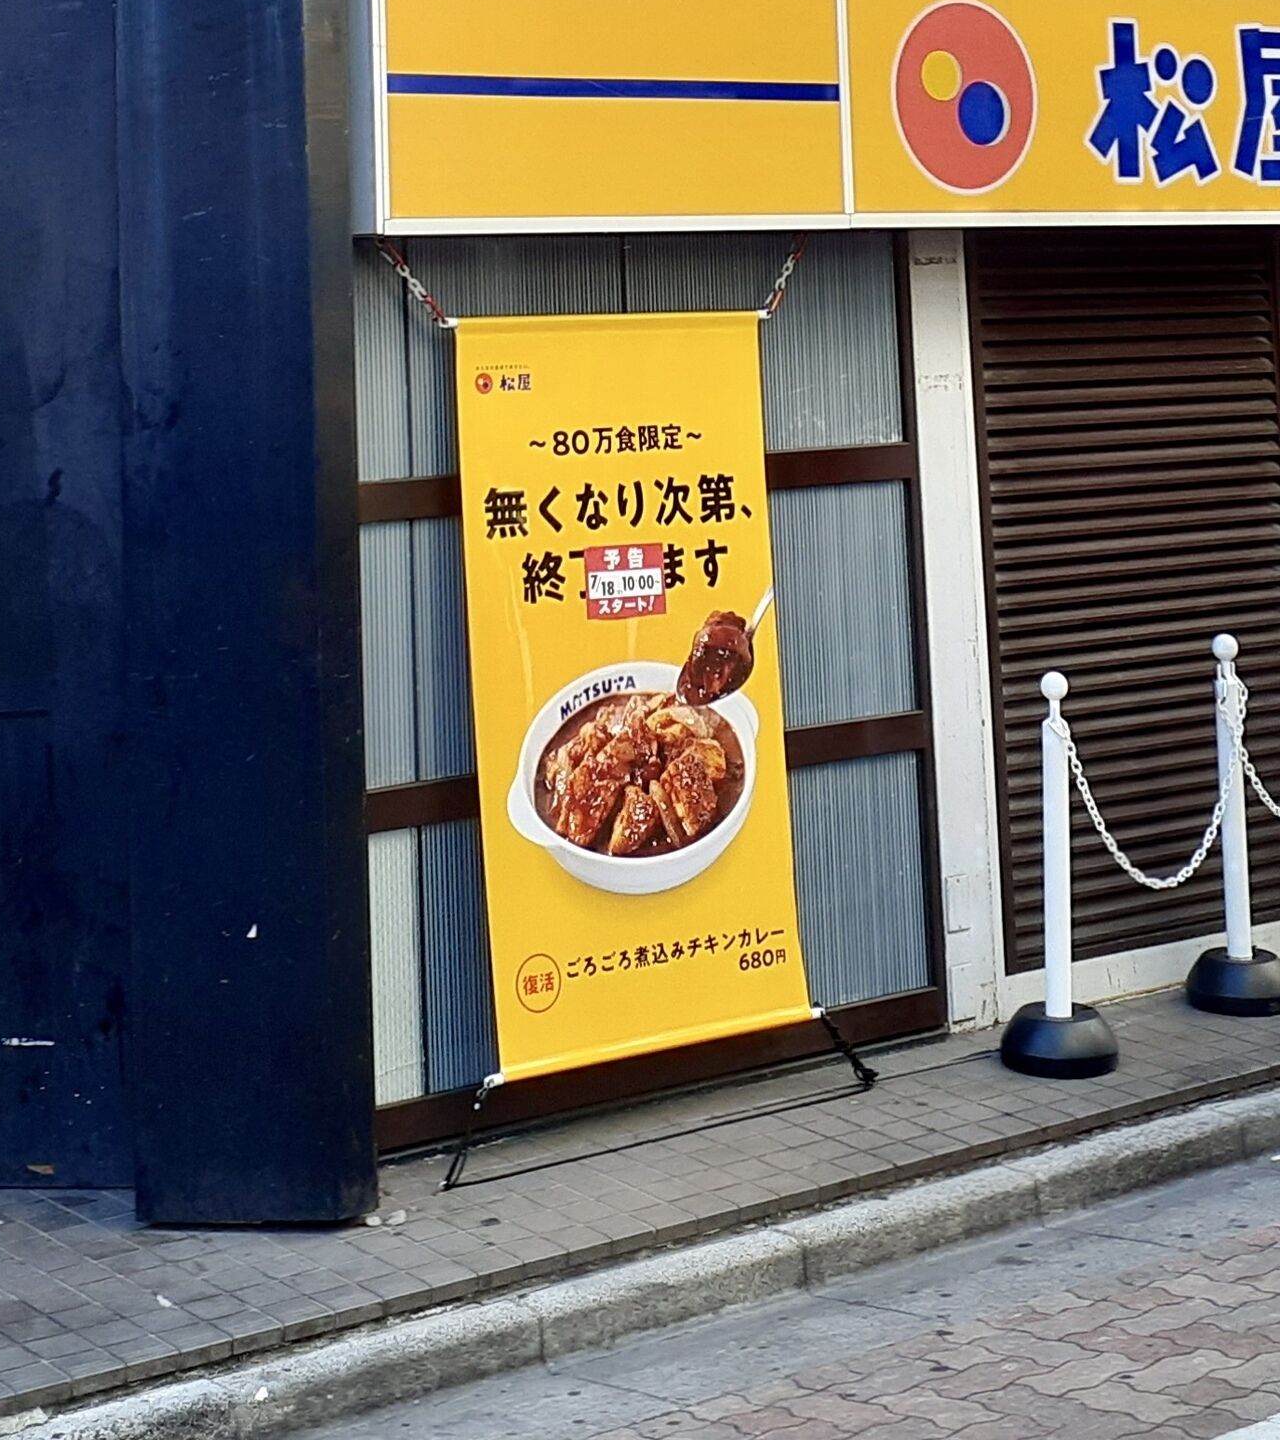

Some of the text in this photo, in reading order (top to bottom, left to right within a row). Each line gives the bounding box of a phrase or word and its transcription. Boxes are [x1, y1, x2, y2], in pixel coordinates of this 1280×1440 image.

[499, 372, 532, 392] 松屋
[483, 472, 754, 540] 無くなり次第、
[521, 538, 729, 605] 終ます
[603, 546, 644, 571] 予告
[566, 925, 786, 981] ごろごろ煮込みチキンカレー
[738, 947, 787, 973] 680円
[522, 970, 556, 997] 復活
